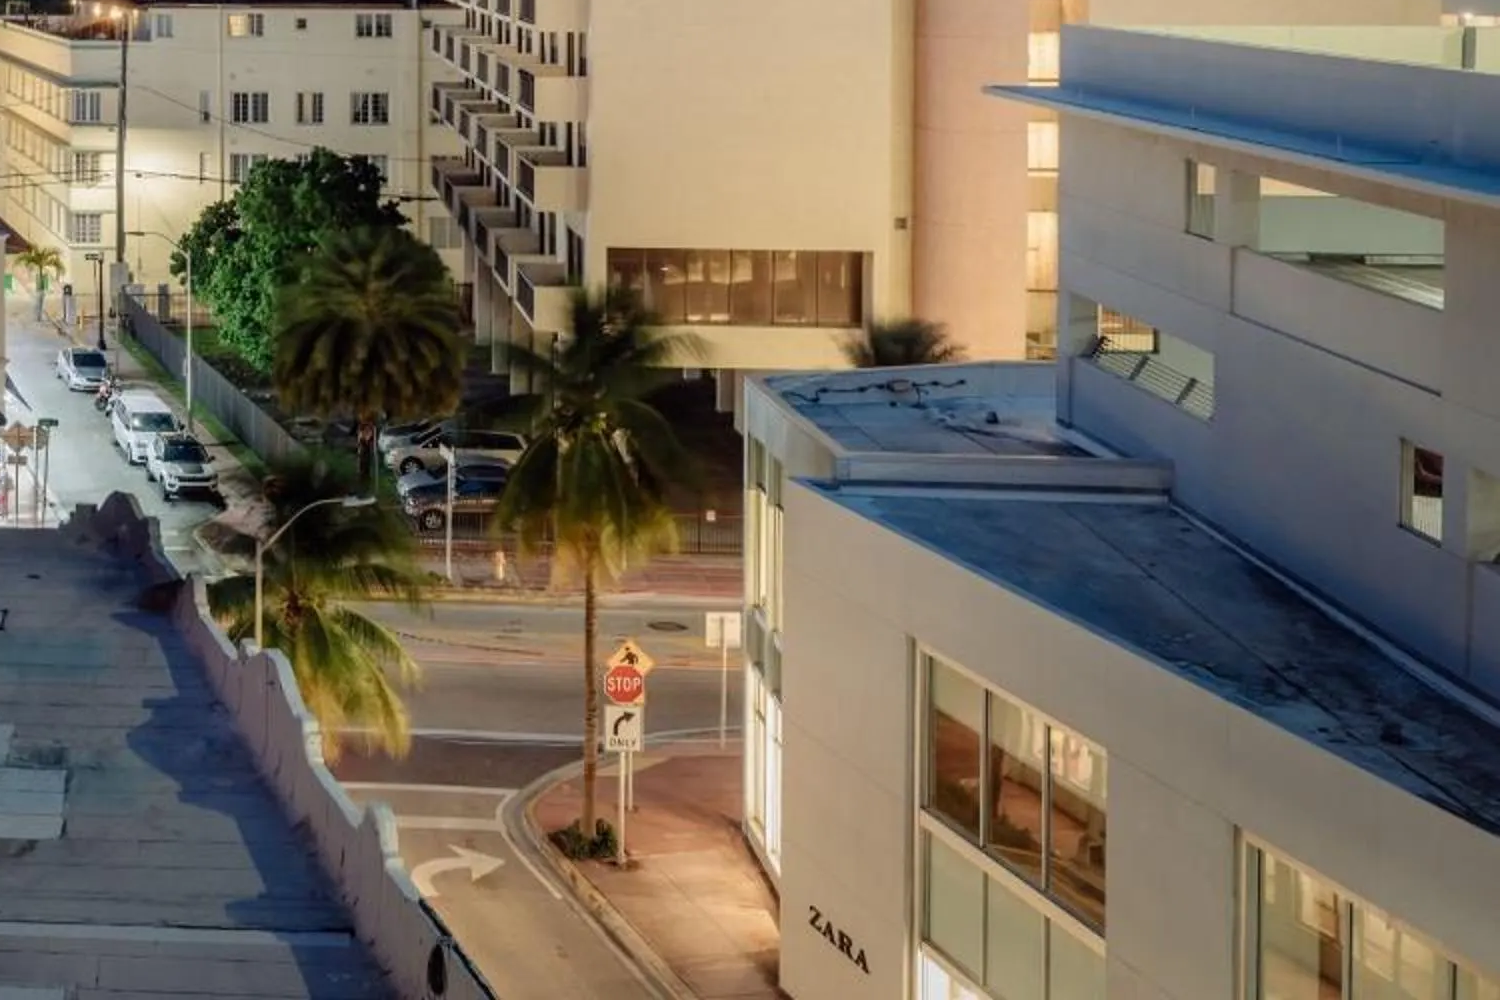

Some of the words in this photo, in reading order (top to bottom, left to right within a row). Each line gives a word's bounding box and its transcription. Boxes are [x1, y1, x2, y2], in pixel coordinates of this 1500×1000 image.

[607, 677, 641, 692] STOP
[609, 738, 637, 747] ONLY
[808, 904, 870, 975] ZARA
